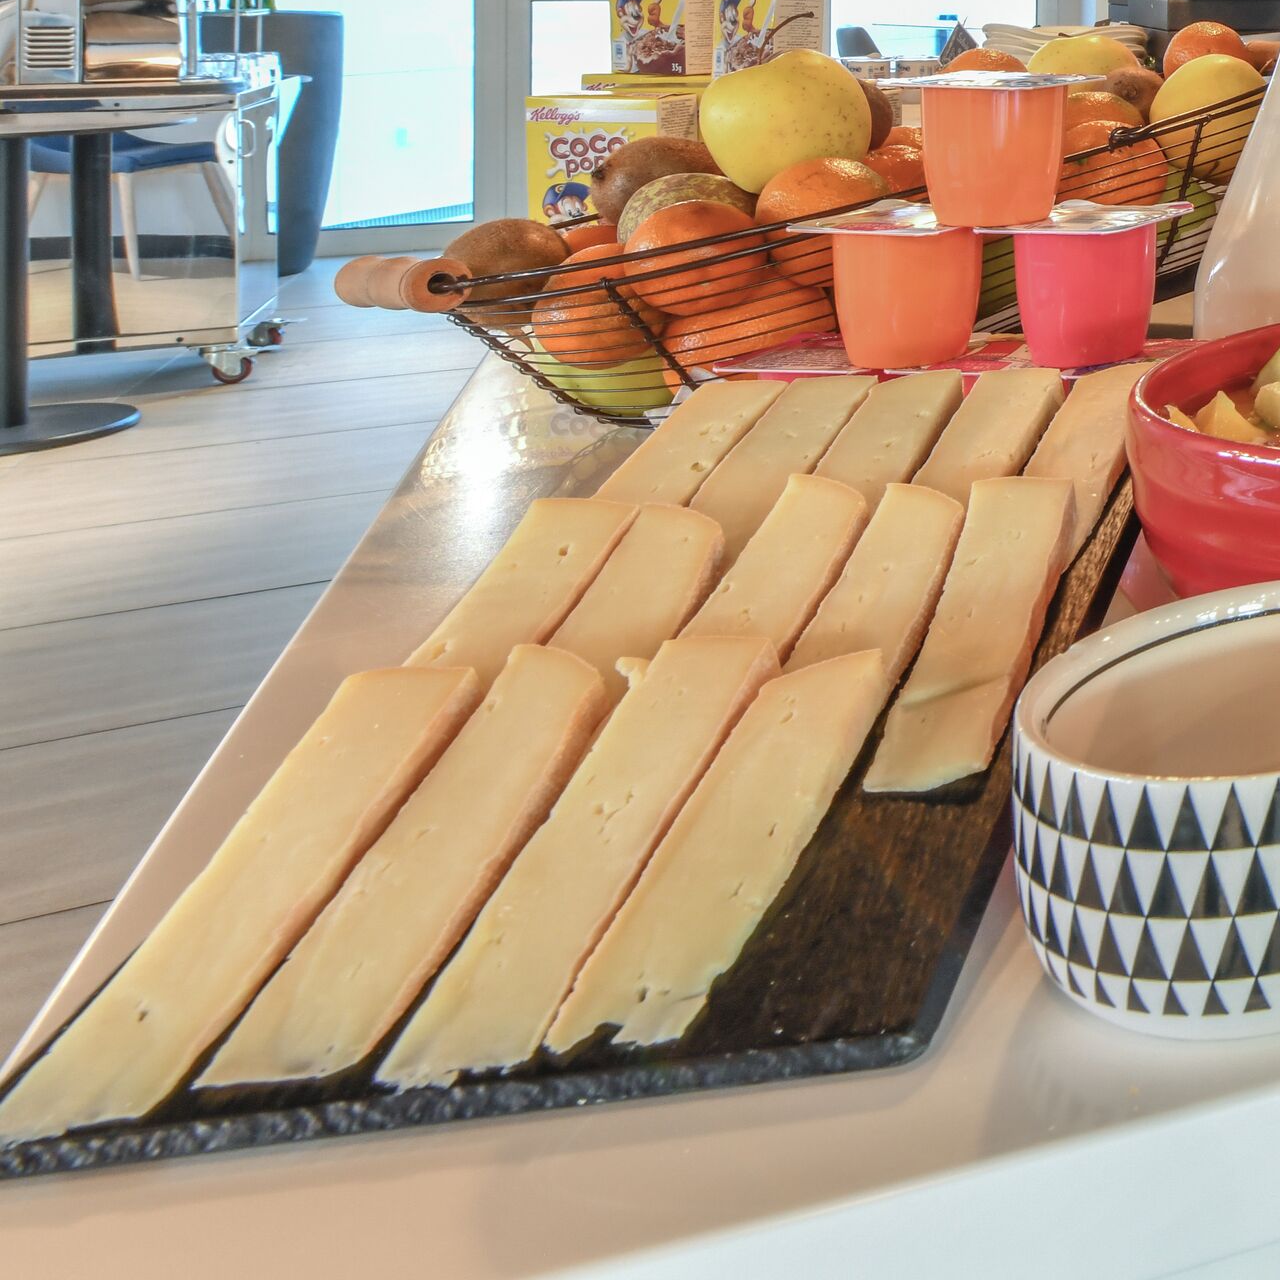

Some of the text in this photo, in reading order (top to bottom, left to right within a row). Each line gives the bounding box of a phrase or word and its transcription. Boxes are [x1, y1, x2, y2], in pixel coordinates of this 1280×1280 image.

[671, 63, 682, 73] 35g
[530, 107, 581, 125] Kellogg's
[565, 154, 605, 179] pop
